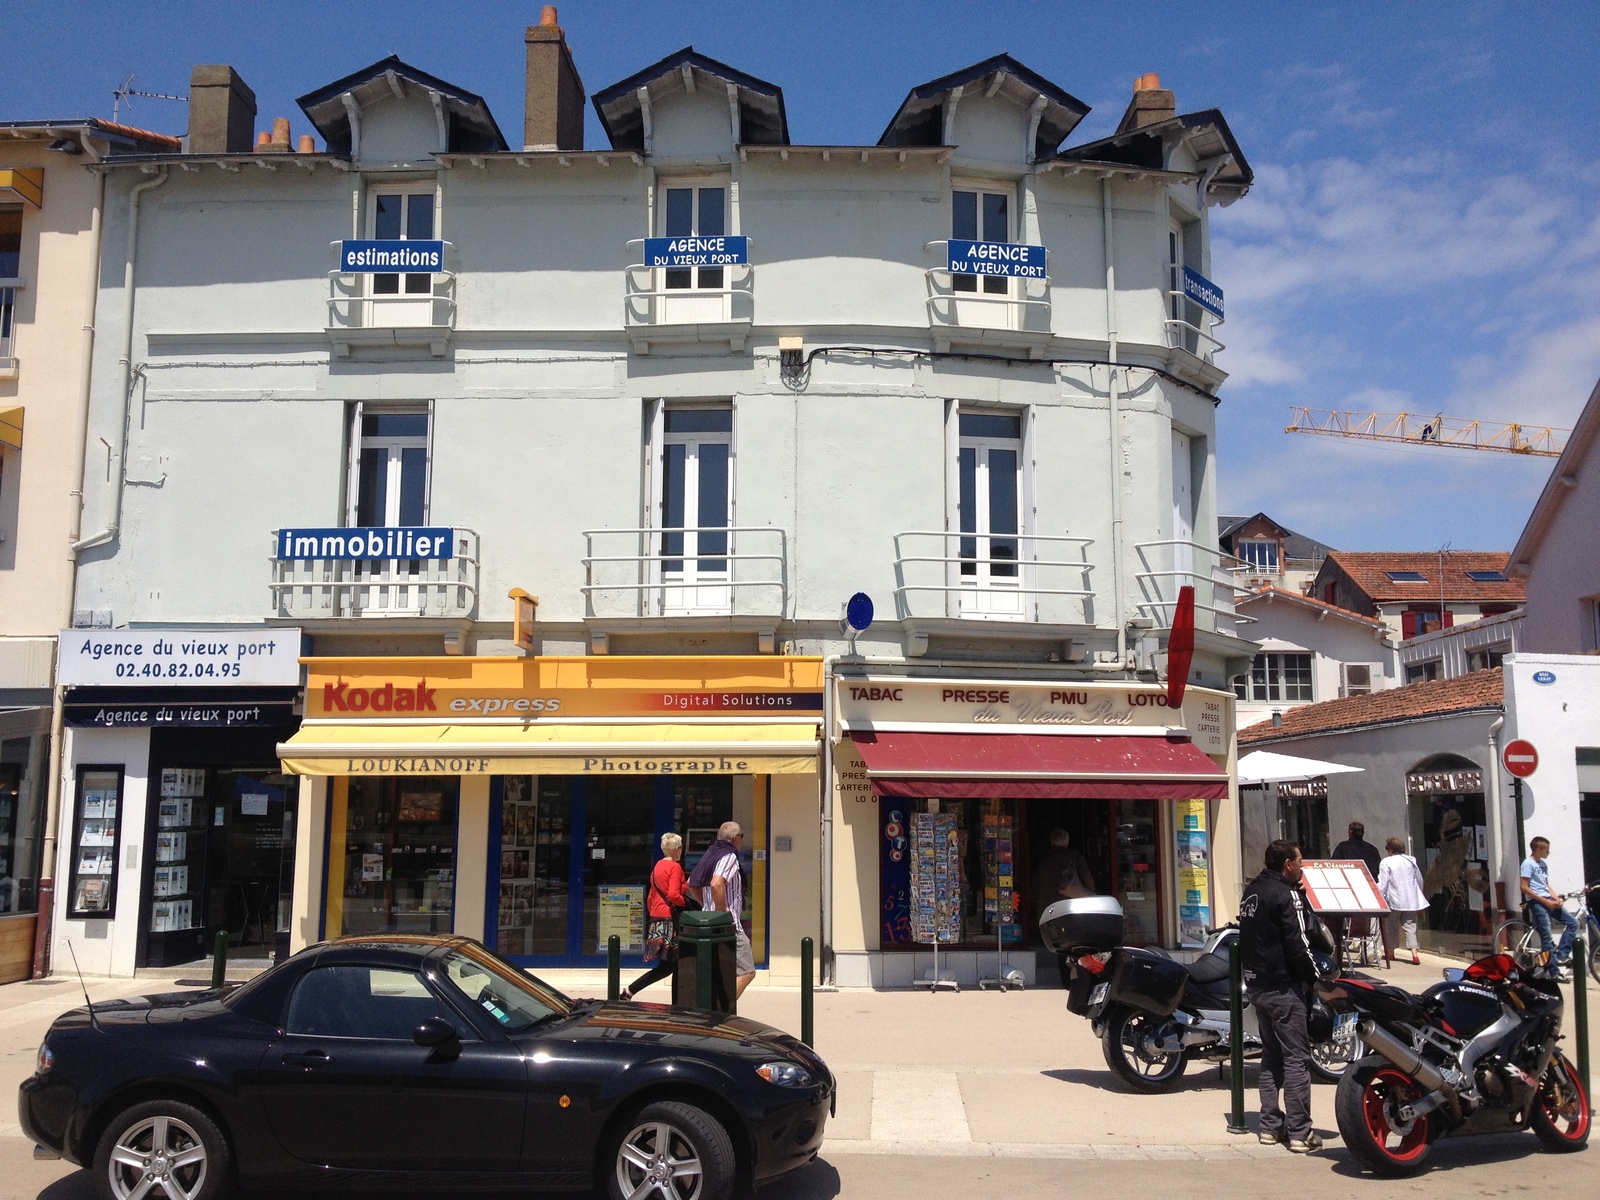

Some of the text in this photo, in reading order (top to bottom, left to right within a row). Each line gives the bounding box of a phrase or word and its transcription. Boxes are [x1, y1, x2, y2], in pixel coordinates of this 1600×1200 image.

[668, 238, 725, 252] AGENCE
[967, 244, 1029, 262] AGENCE
[347, 248, 439, 266] estimations
[654, 254, 739, 266] DU VIEUX PORT
[951, 260, 1044, 277] DU VIEUX PORT
[1185, 273, 1224, 312] transactions
[285, 531, 445, 557] immobilier
[80, 639, 276, 660] Agence du vieux port
[116, 663, 241, 678] 02.40.82.04.95
[323, 682, 561, 715] Kodak express
[663, 694, 793, 709] Digital Solutions
[849, 687, 1168, 707] TABAC PRESSE PMU LOTO
[1012, 697, 1076, 723] Vieux
[1082, 698, 1134, 726] Port
[1205, 702, 1220, 711] TABAC
[94, 707, 260, 726] Agence du vieux port
[1201, 713, 1220, 723] PRESSE
[1198, 724, 1220, 733] CARTERIE
[347, 757, 748, 773] LOUKIANOFF Photographe
[842, 772, 870, 780] PRES
[835, 783, 872, 791] CARTERI
[884, 895, 896, 911] 5
[898, 890, 905, 901] 2
[1458, 985, 1498, 1000] Kawasaki
